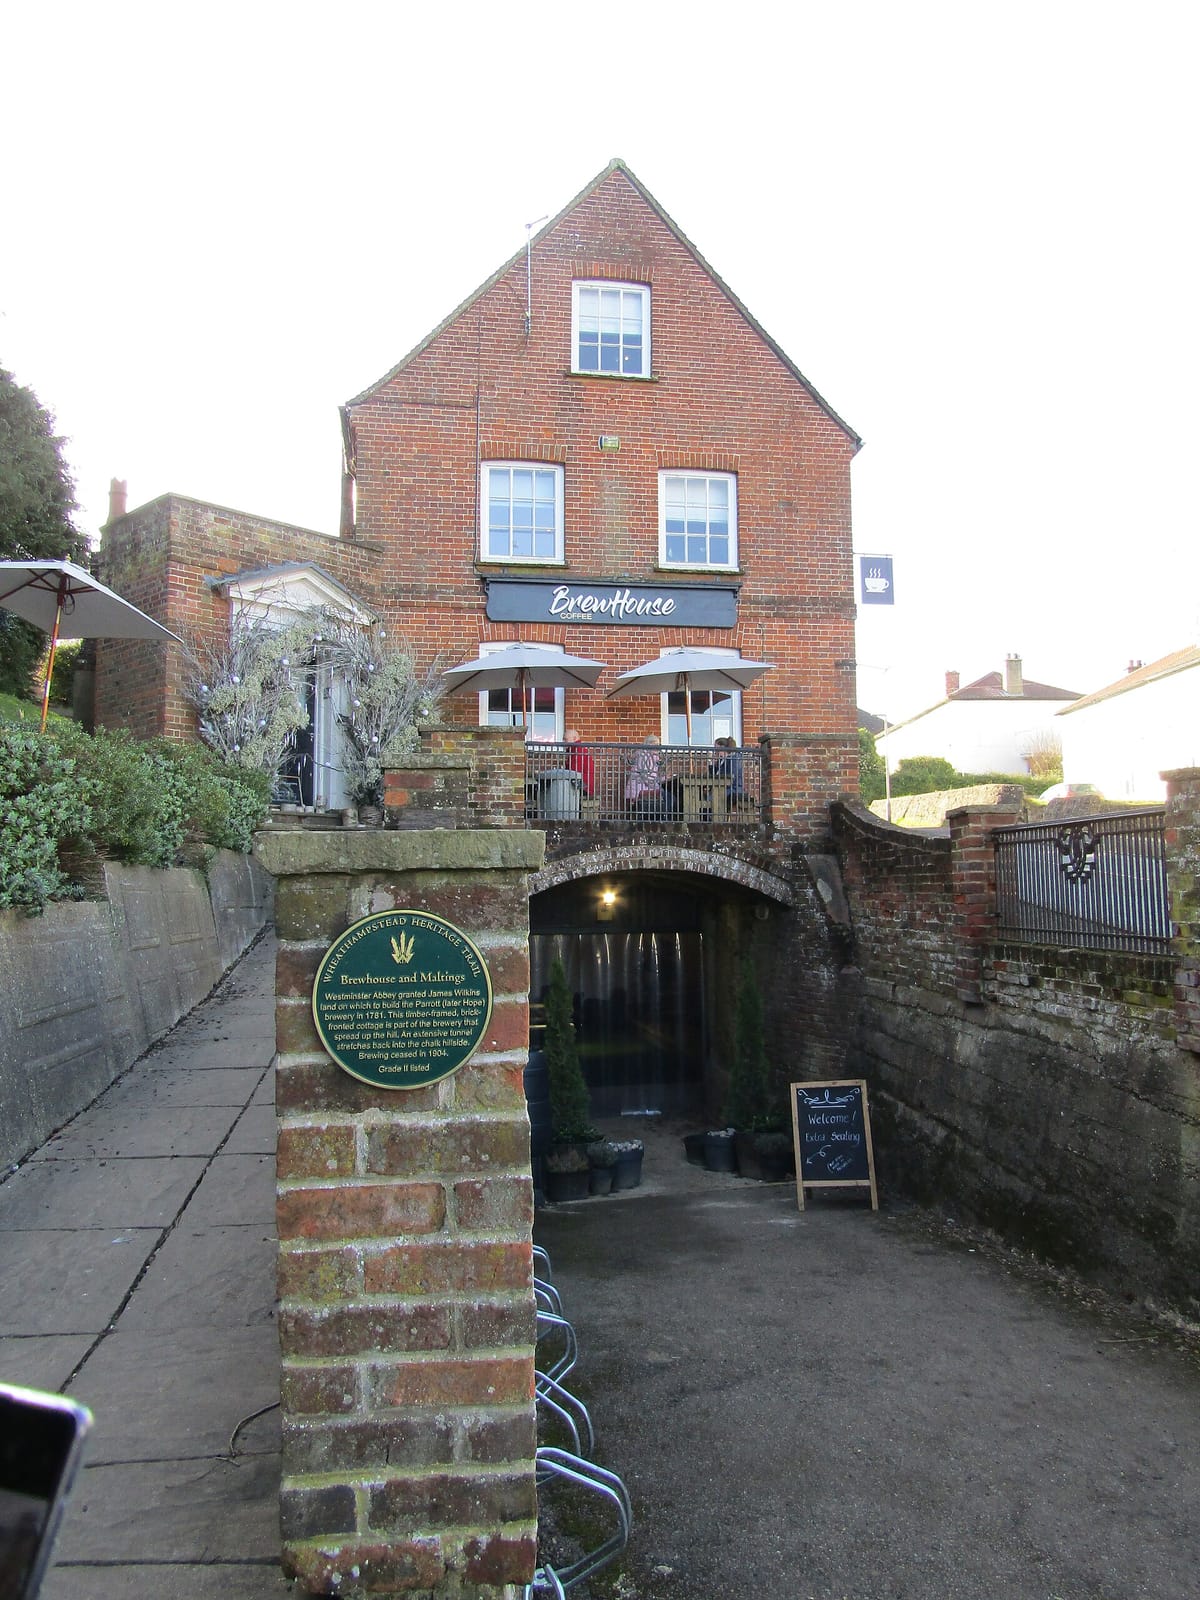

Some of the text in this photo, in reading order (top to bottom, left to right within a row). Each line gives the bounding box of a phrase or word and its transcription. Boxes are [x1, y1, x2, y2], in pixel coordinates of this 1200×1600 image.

[548, 585, 676, 619] BrewHouse
[559, 612, 592, 620] COFFEE
[322, 917, 481, 983] WHEATHAMPSTEAD HERITAGE TRAIL
[340, 971, 465, 986] Brewhouse and Maltings
[324, 988, 481, 1001] Westminster Abbey granted James Wilkins
[320, 1003, 337, 1012] land
[349, 1002, 371, 1010] which
[372, 1002, 381, 1010] to
[382, 1001, 400, 1010] build
[401, 1000, 414, 1008] the
[415, 1000, 441, 1009] Parrott
[441, 1000, 461, 1009] (later
[462, 999, 486, 1008] Hope)
[324, 1008, 482, 1022] brewery in 1781. This timber-framed, brick-
[328, 1018, 478, 1031] fronted cottage is part of the brewery that
[334, 1028, 473, 1042] spread up the hill. An extensive tunnel
[336, 1037, 471, 1051] stretches back into the chalk hillside.
[358, 1049, 449, 1061] Brewing ceased in 1904.
[378, 1065, 402, 1074] Grade
[410, 1063, 431, 1072] listed
[805, 1131, 861, 1145] Extra Seating
